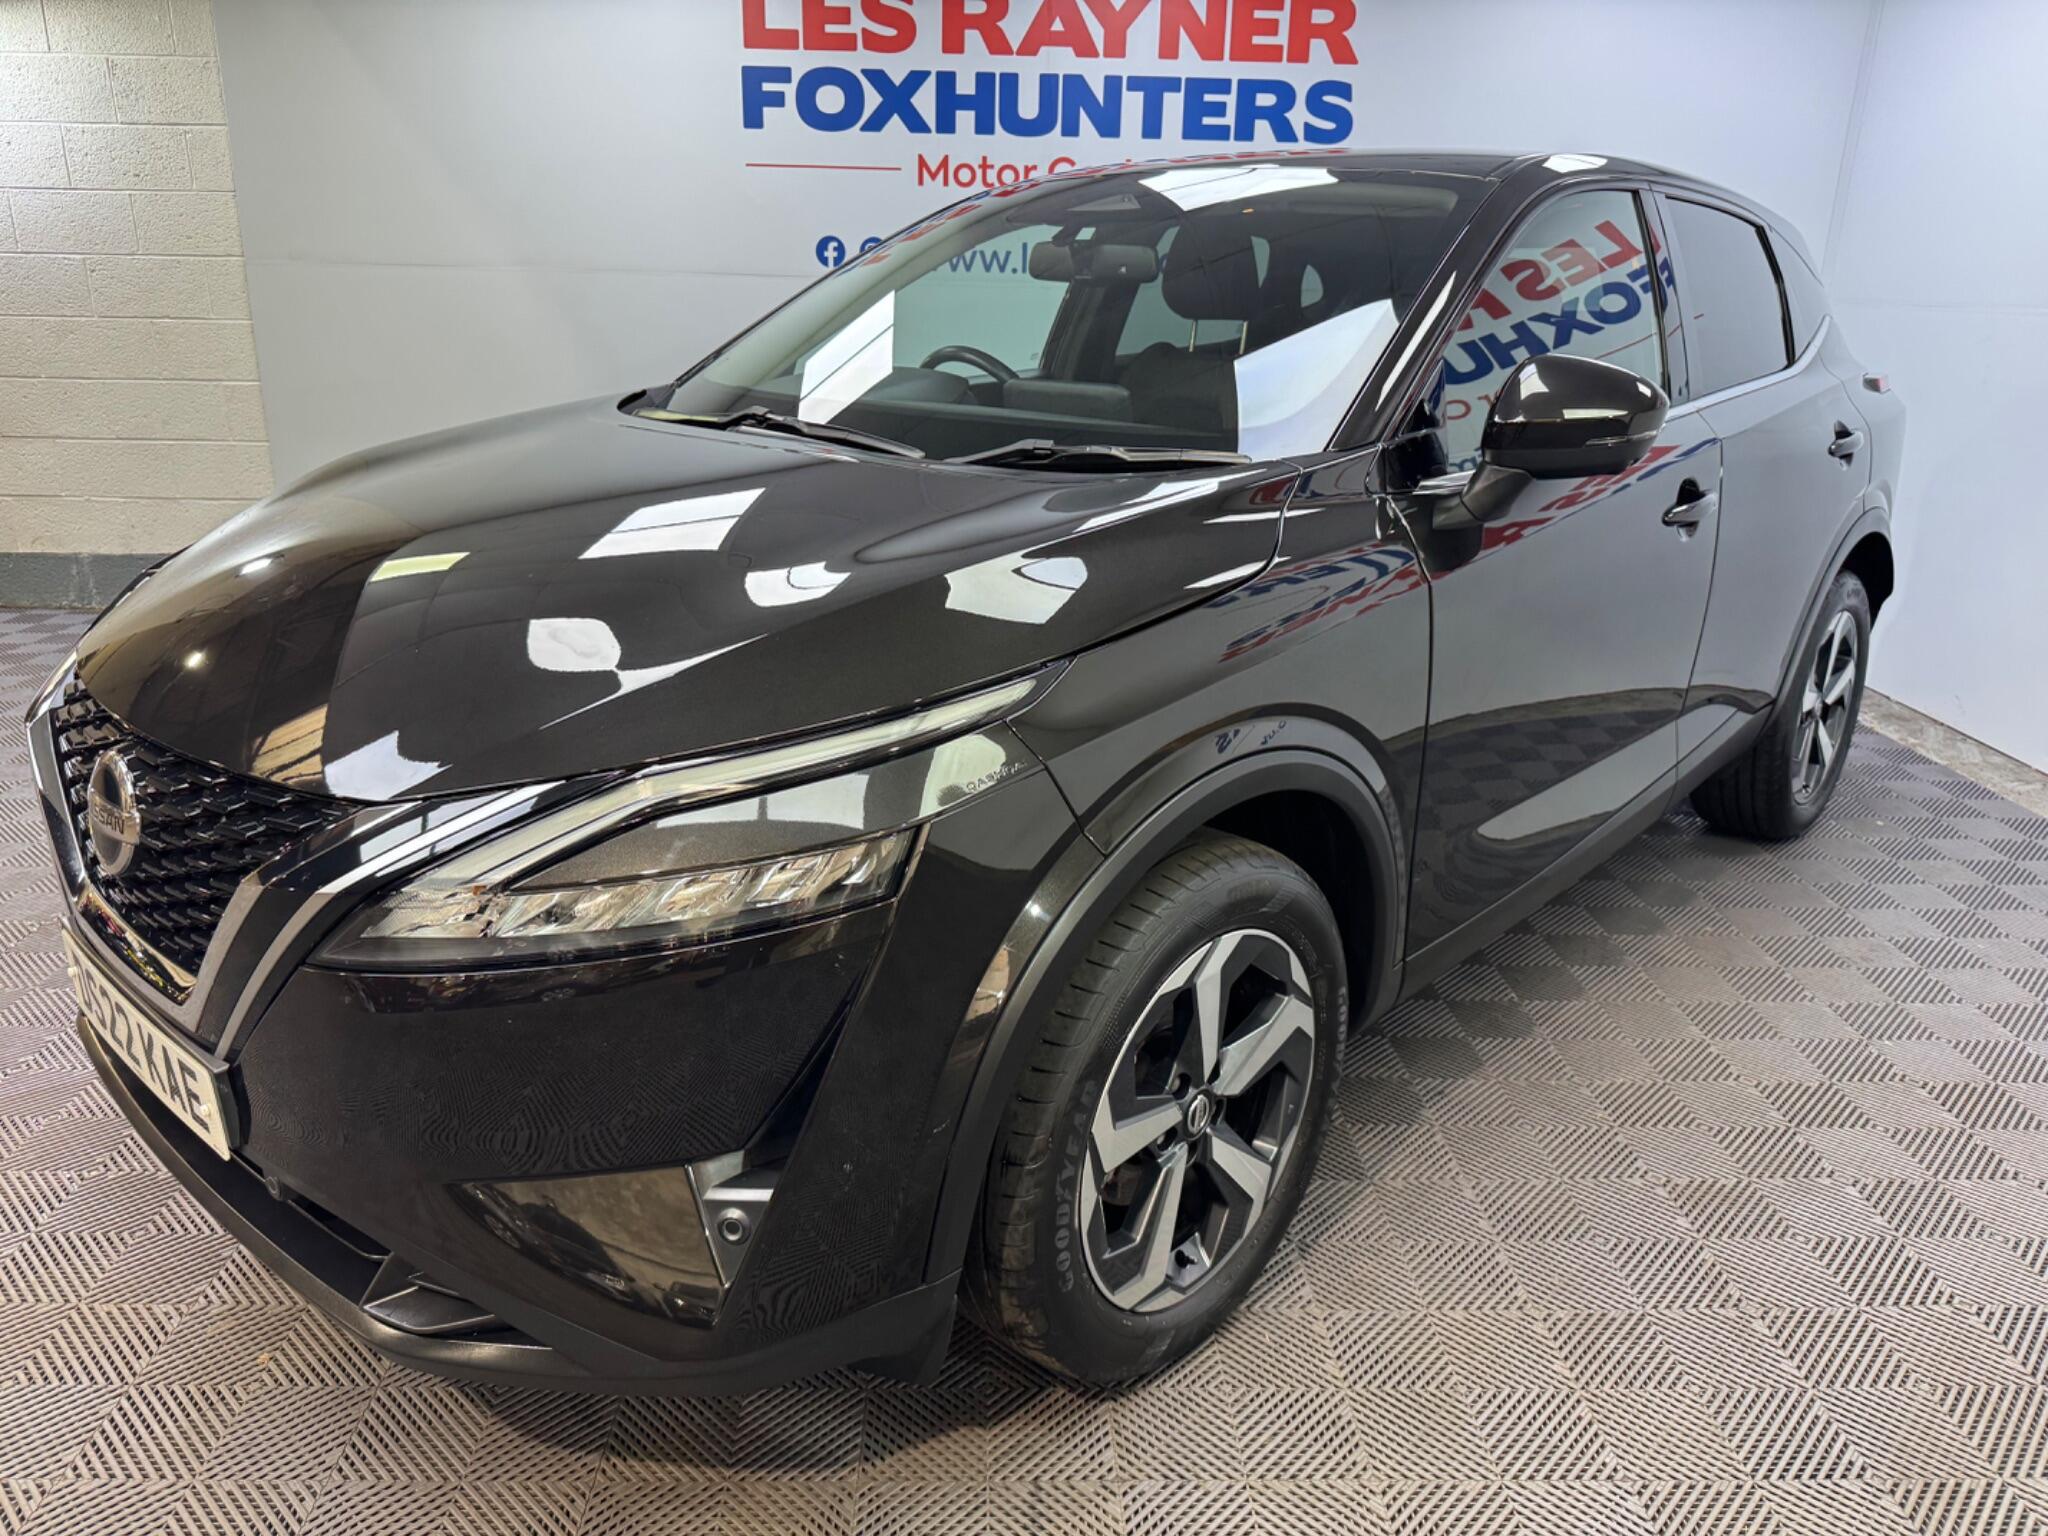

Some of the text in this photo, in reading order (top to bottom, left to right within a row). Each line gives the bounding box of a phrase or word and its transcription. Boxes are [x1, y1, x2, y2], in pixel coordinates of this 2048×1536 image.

[742, 0, 1359, 65] LES RAYNER
[741, 65, 1354, 144] FOXHUNTERS
